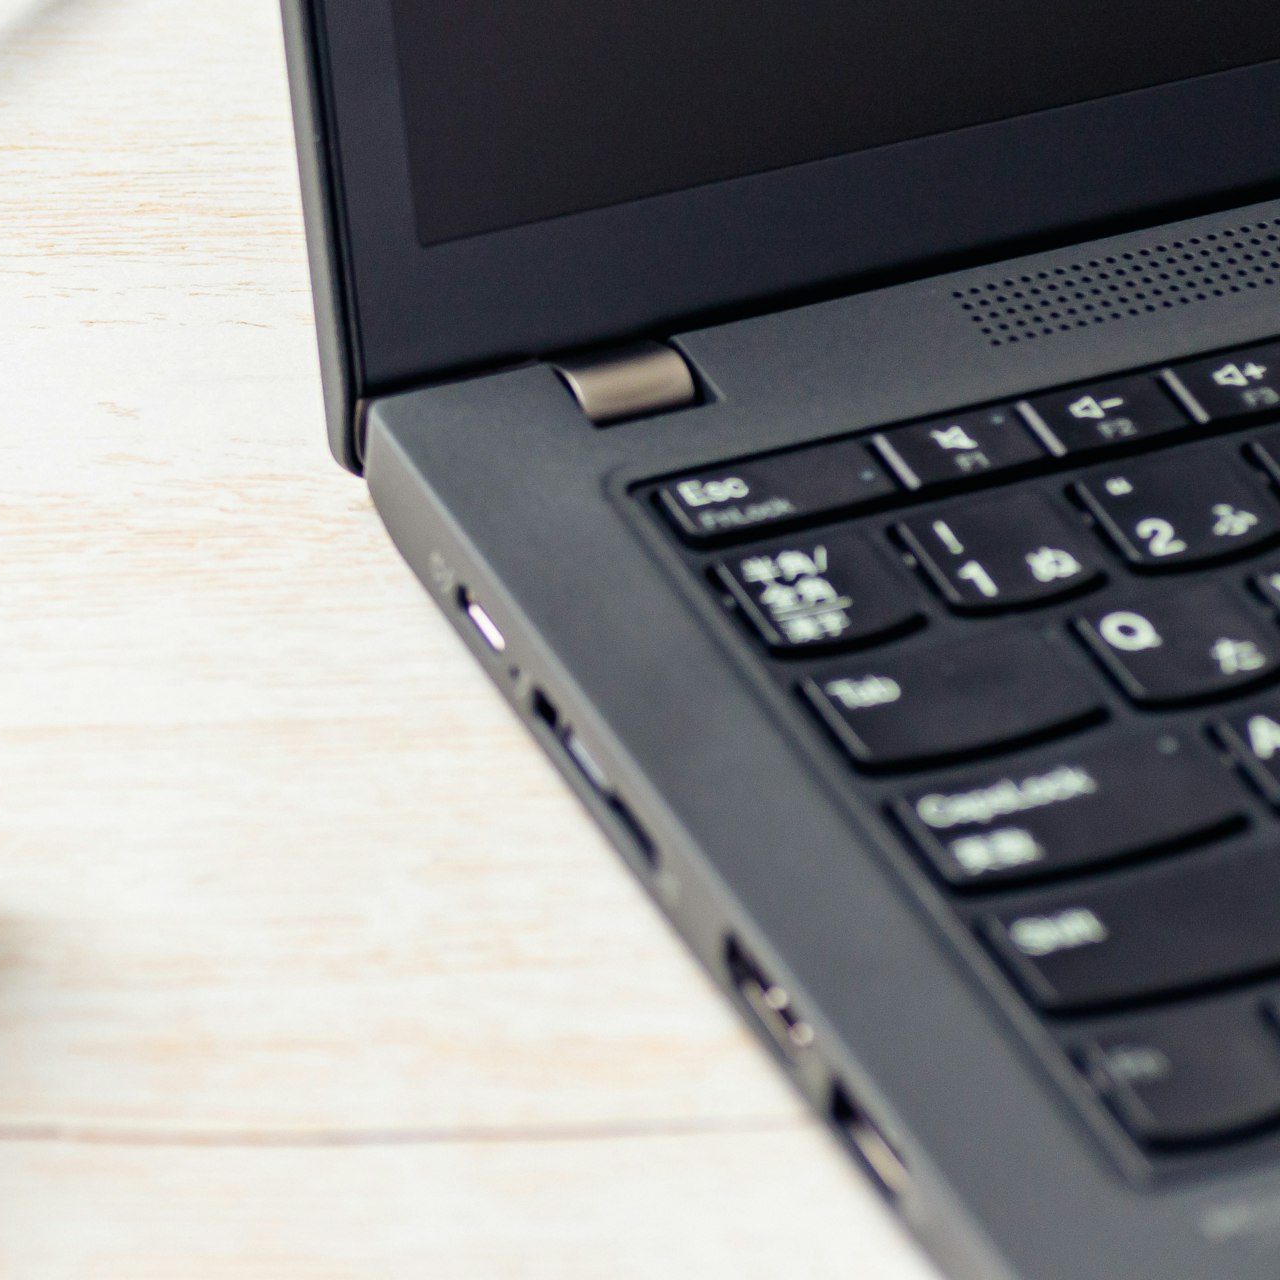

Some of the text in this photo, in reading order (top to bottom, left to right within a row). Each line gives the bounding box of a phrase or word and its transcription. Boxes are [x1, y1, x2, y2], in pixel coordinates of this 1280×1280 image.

[677, 477, 750, 508] Esc
[1135, 517, 1188, 558] 2
[957, 560, 1000, 598] 1
[1099, 611, 1164, 652] Q
